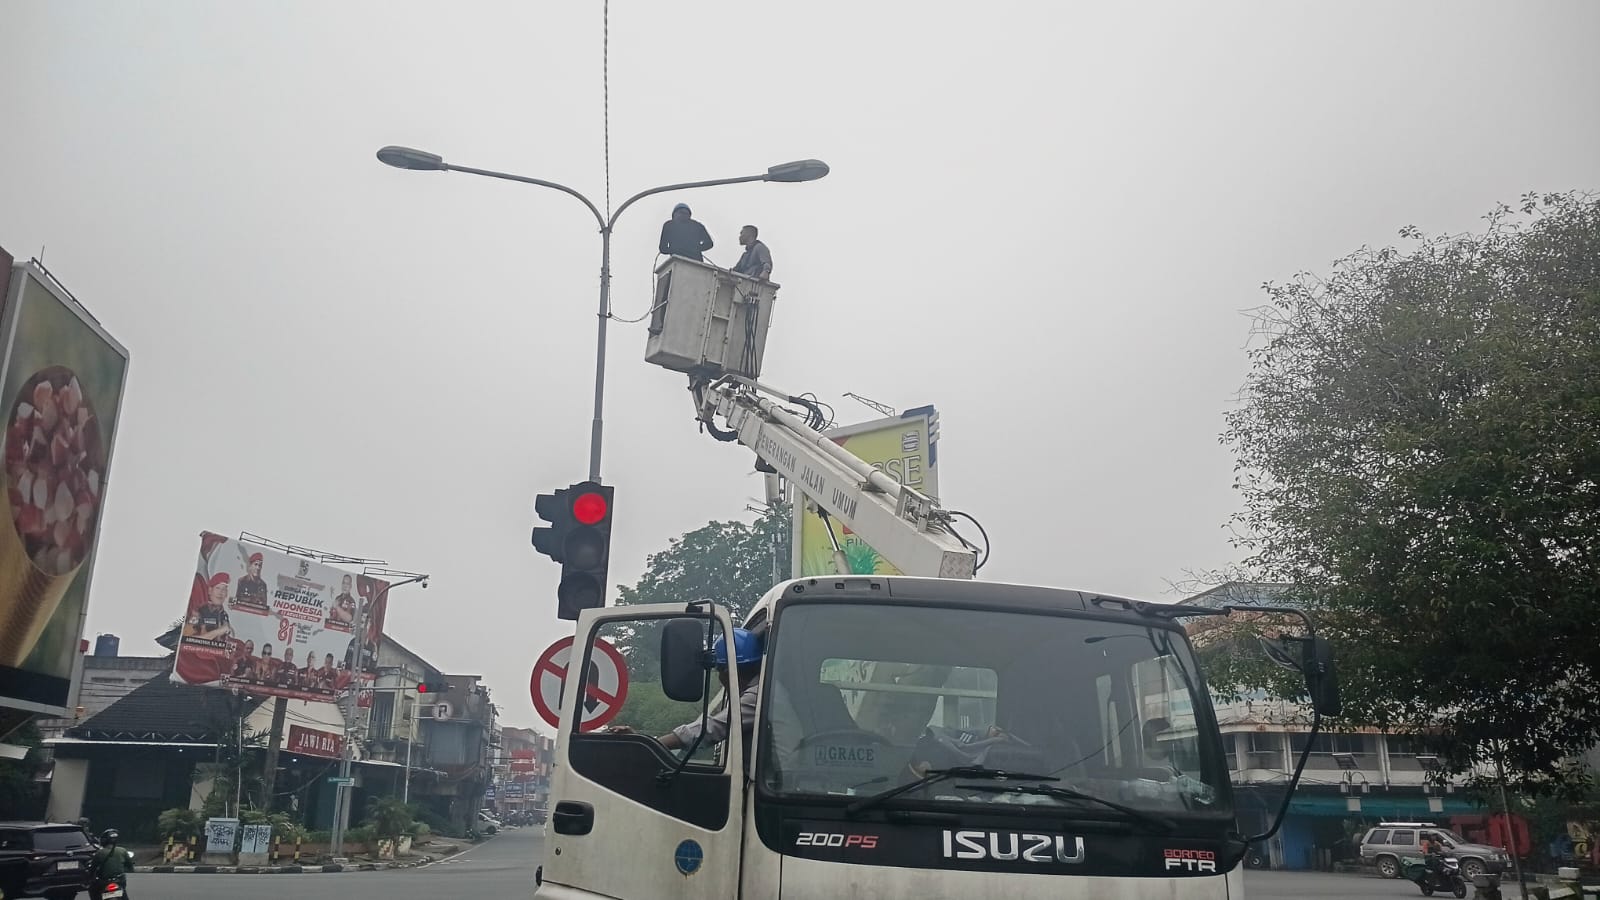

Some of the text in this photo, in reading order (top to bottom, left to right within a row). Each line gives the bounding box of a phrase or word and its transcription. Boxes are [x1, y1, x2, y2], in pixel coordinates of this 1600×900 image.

[801, 465, 825, 495] JALAN
[832, 487, 857, 521] UMUM
[273, 599, 322, 617] INDONESIA
[274, 590, 323, 608] REPUBLIK
[299, 733, 335, 753] JAWI RIA
[828, 746, 875, 762] GRACE
[796, 832, 879, 849] 200 PS
[943, 830, 1085, 863] ISUZU
[1164, 848, 1215, 860] BORNEO
[1165, 858, 1216, 873] FTR
